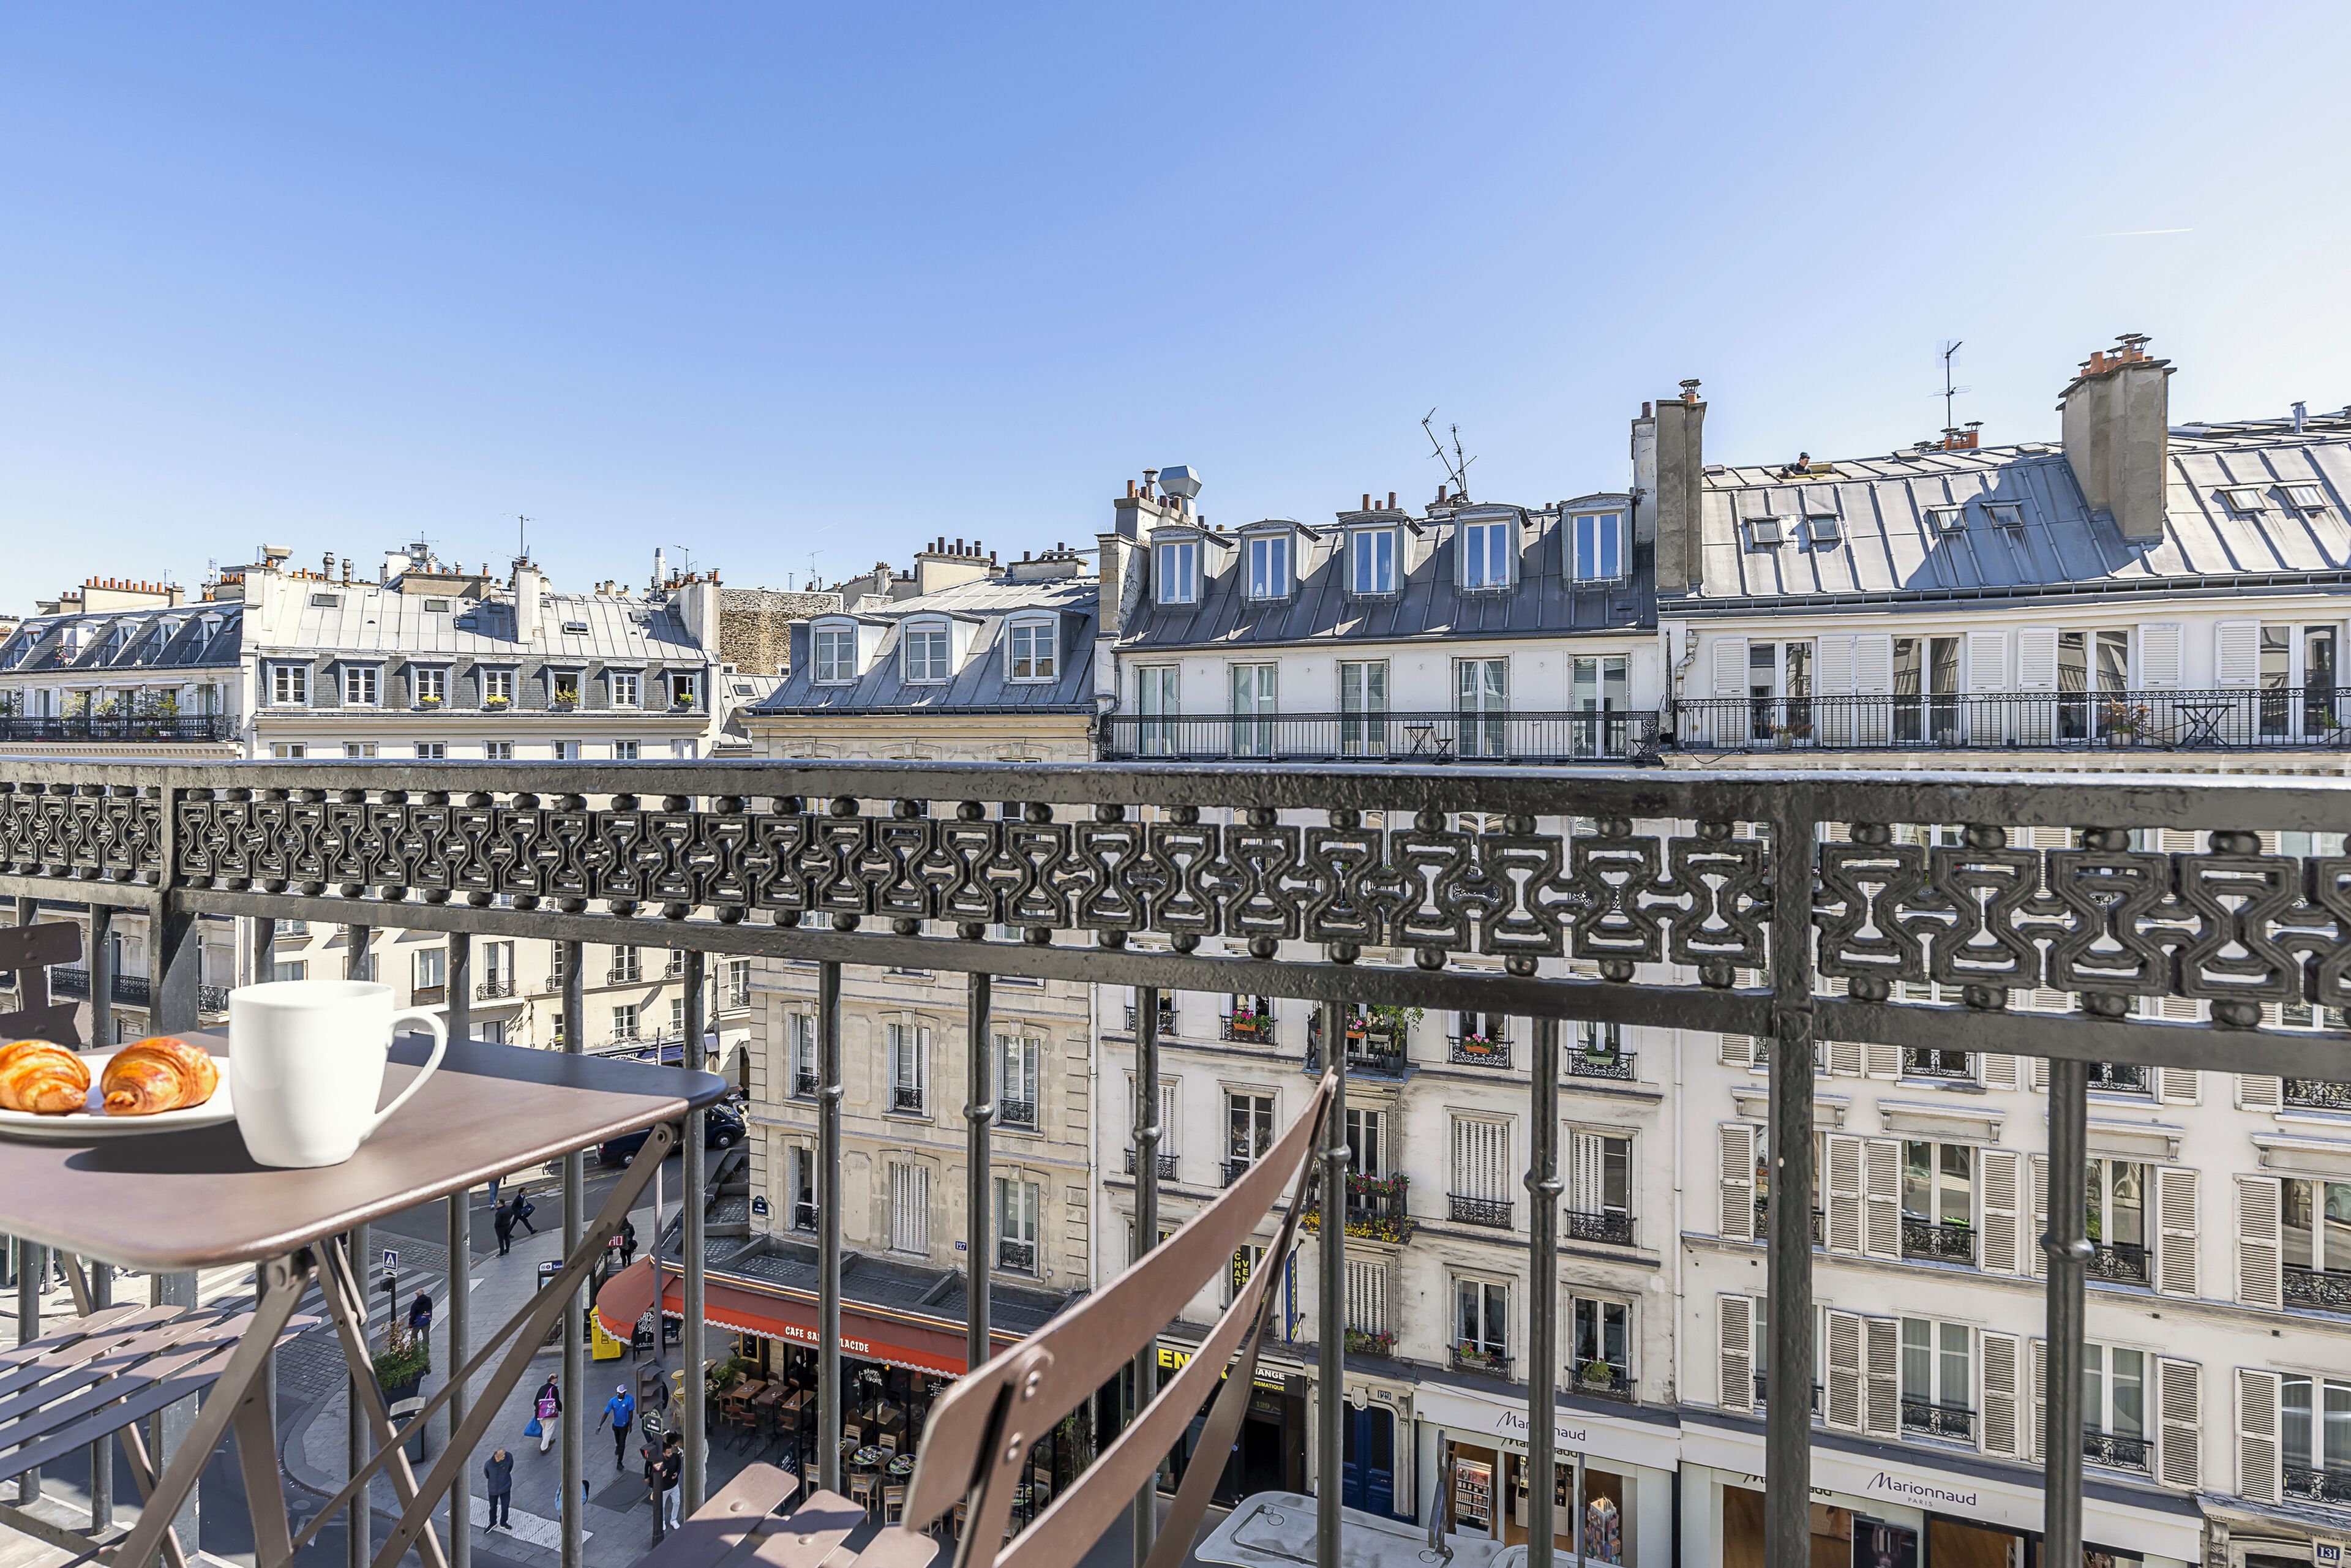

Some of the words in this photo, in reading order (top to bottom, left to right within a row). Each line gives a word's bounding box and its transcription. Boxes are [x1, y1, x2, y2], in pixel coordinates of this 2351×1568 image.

[785, 1326, 804, 1338] CAFE
[839, 1338, 869, 1353] LACIDE
[1255, 1367, 1285, 1381] ANGE
[1378, 1390, 1390, 1400] 129
[1867, 1472, 1976, 1506] Marionnaud
[1907, 1497, 1933, 1507] PARIS
[2320, 1547, 2337, 1559] 131
